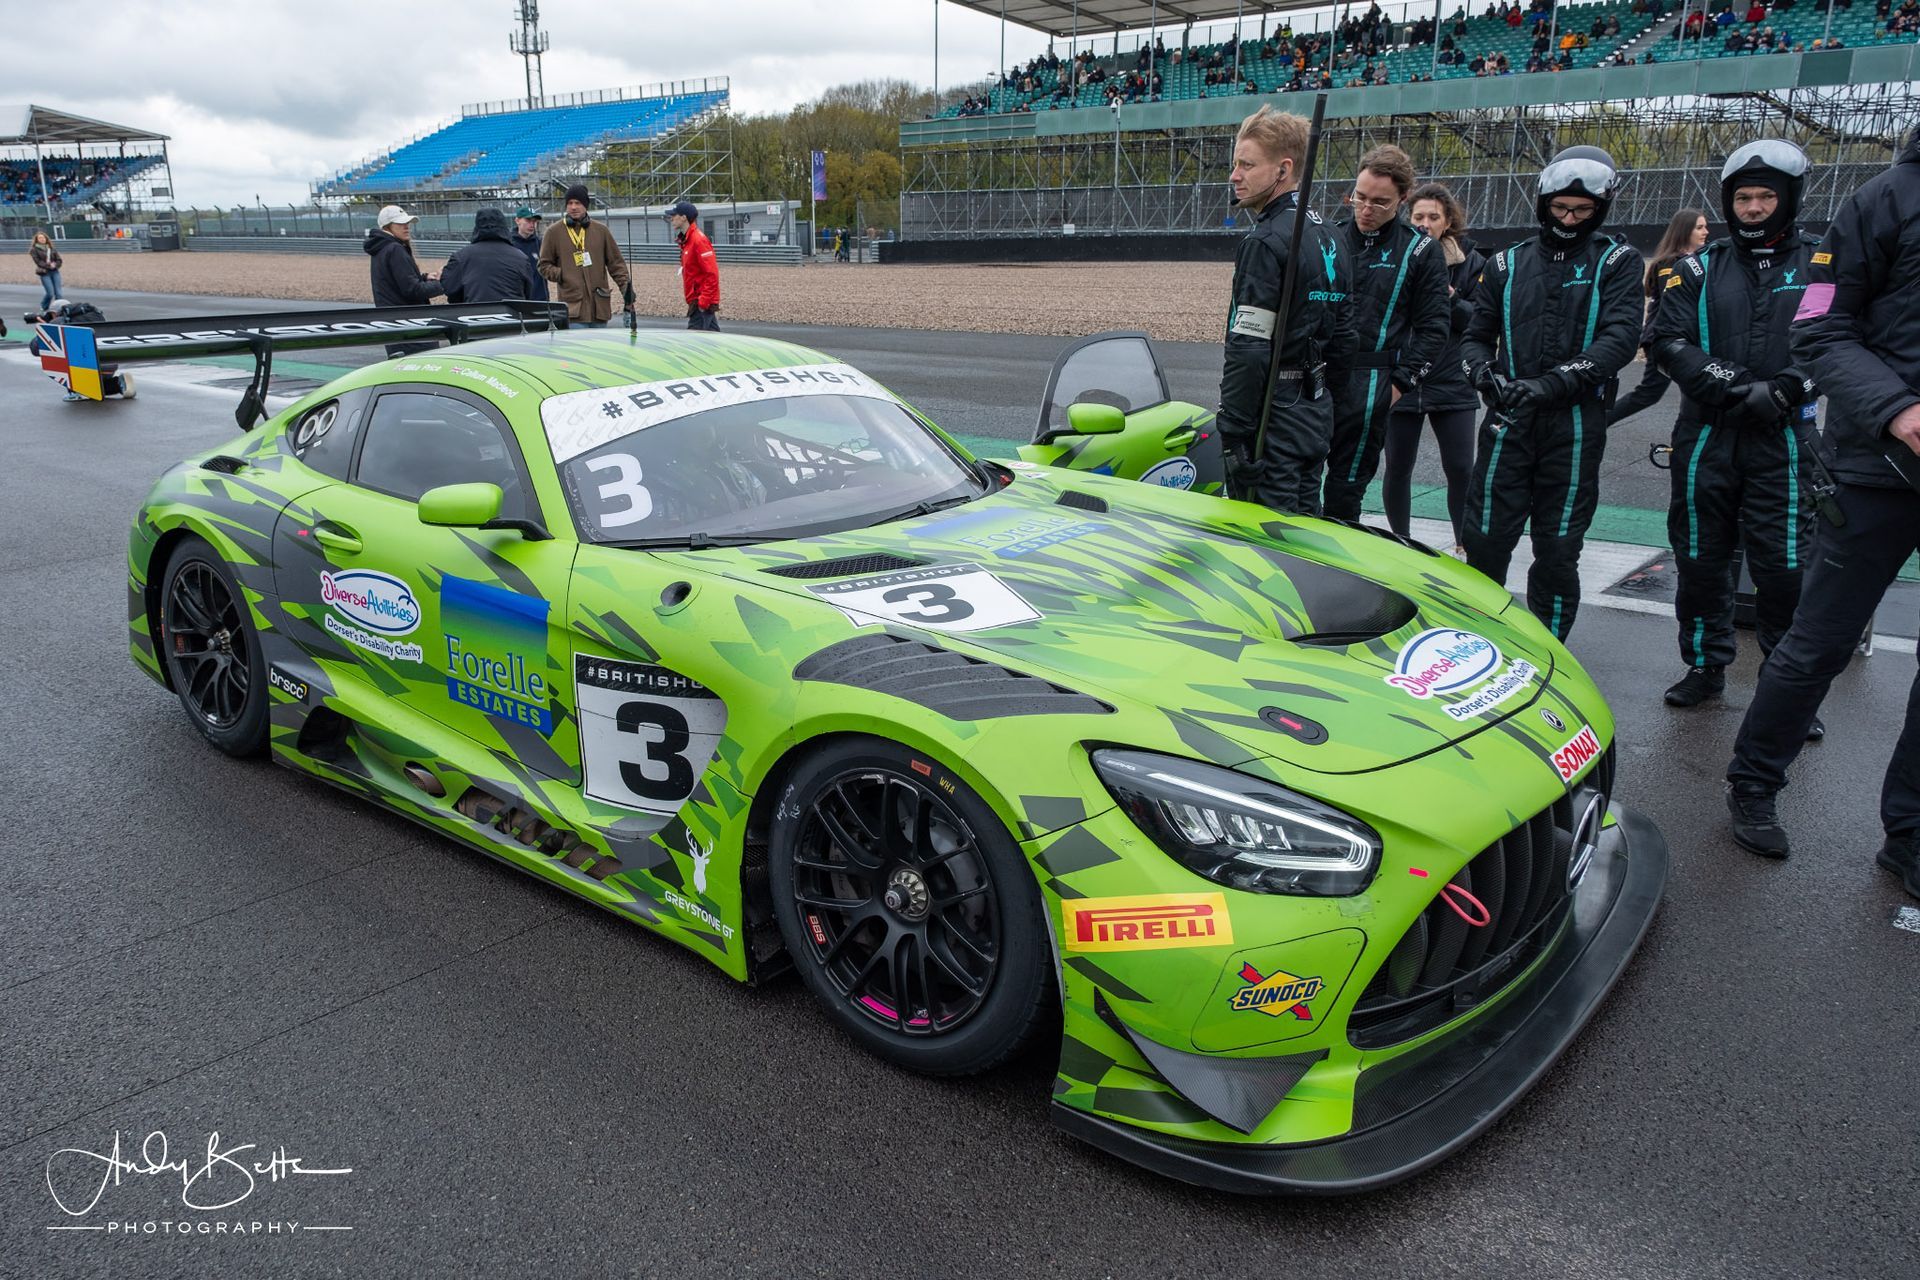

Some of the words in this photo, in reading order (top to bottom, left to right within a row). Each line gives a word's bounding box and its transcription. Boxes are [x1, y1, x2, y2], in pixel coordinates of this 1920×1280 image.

[601, 370, 861, 419] #BRITISHGT
[584, 453, 654, 528] 3
[882, 584, 974, 623] 3
[327, 617, 359, 641] Dorset's
[359, 633, 394, 656] Disability
[394, 645, 421, 660] Charity
[270, 667, 304, 700] brscc
[444, 633, 545, 702] Forelle
[456, 682, 542, 727] ESTATES
[1447, 692, 1494, 718] Dorset's
[1491, 668, 1523, 700] Disability
[616, 701, 694, 801] 3
[1553, 728, 1600, 779] SONAX
[664, 890, 722, 931] GREYSTONE
[722, 924, 735, 940] GT
[809, 914, 826, 943] BBS
[1075, 904, 1216, 943] PIRELLI
[1235, 979, 1319, 1008] SUNOCO
